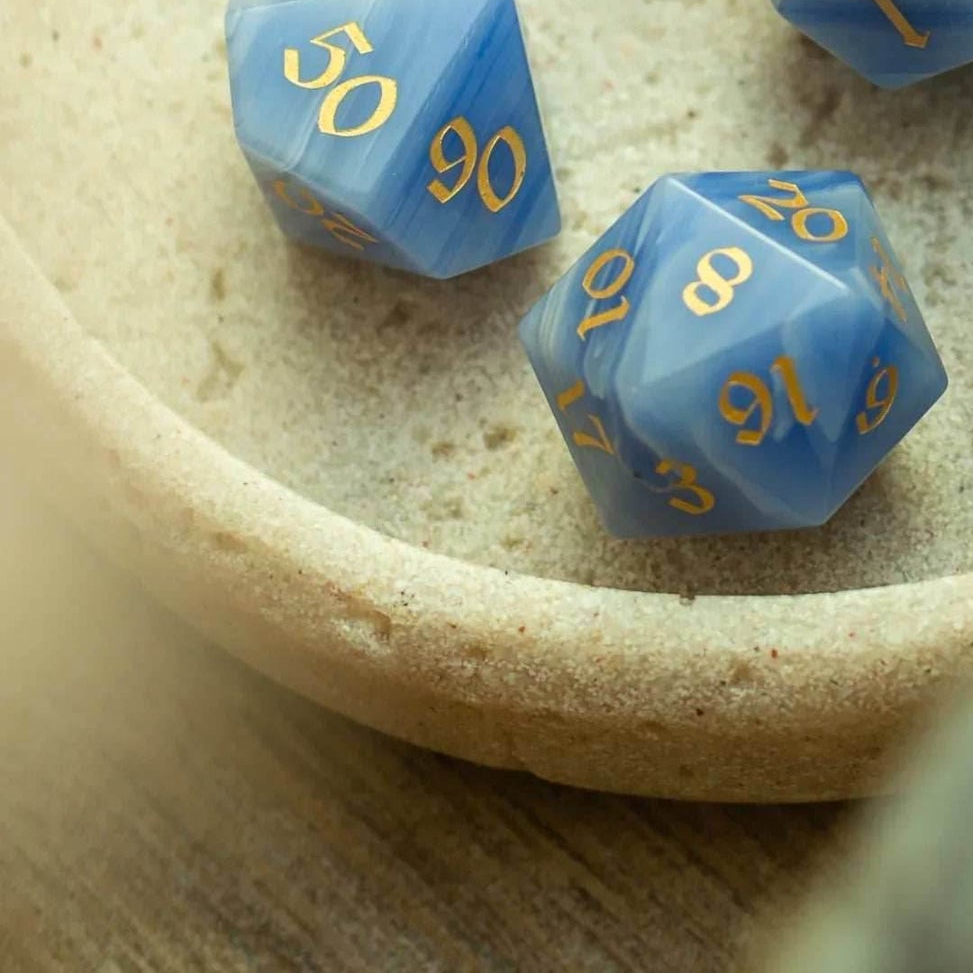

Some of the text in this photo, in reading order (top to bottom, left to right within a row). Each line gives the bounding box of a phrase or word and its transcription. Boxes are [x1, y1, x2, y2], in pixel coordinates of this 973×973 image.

[283, 21, 398, 138] 50
[426, 115, 527, 214] 90
[738, 178, 849, 243] 20
[576, 248, 635, 342] 10
[682, 246, 754, 317] 8
[718, 355, 821, 447] 16
[655, 457, 716, 516] 3
